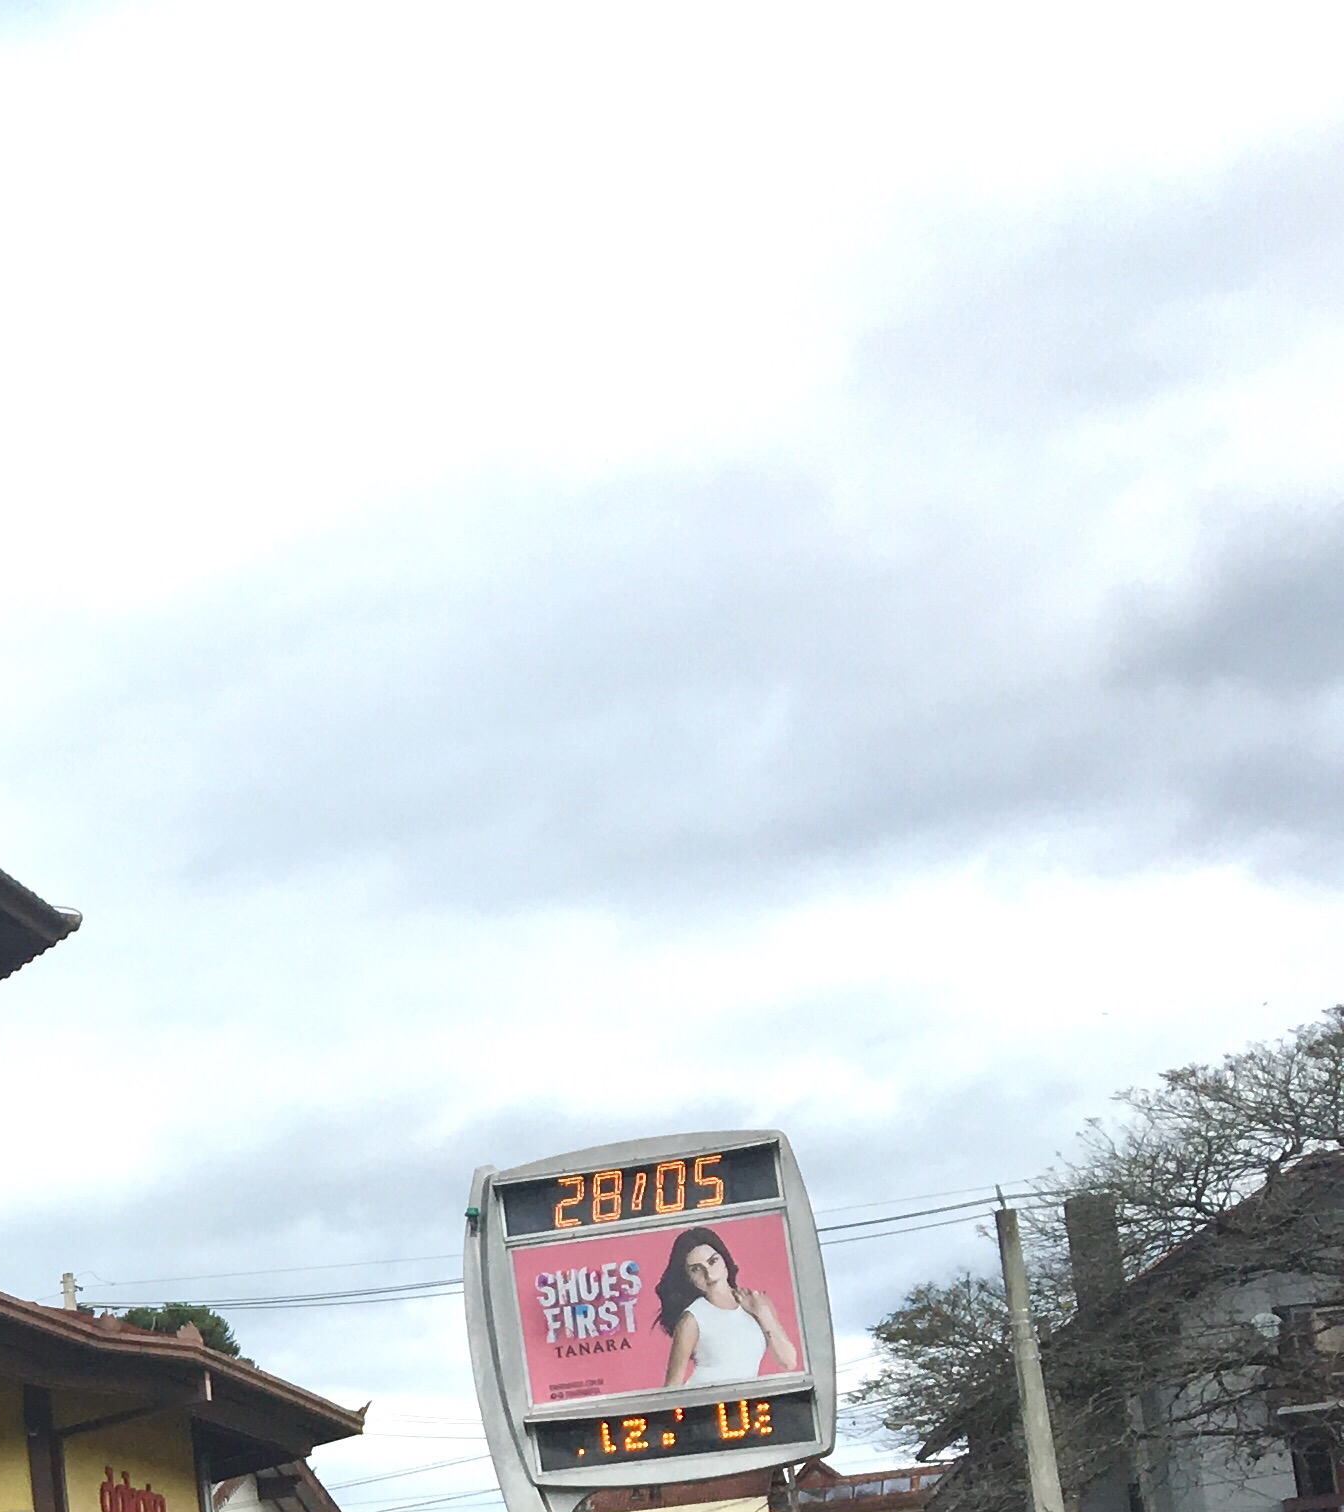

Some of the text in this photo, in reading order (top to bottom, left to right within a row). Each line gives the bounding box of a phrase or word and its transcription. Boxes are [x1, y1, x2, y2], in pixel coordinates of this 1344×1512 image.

[535, 1260, 643, 1308] SHOES
[543, 1298, 639, 1343] FIRST
[554, 1337, 633, 1360] TANARA
